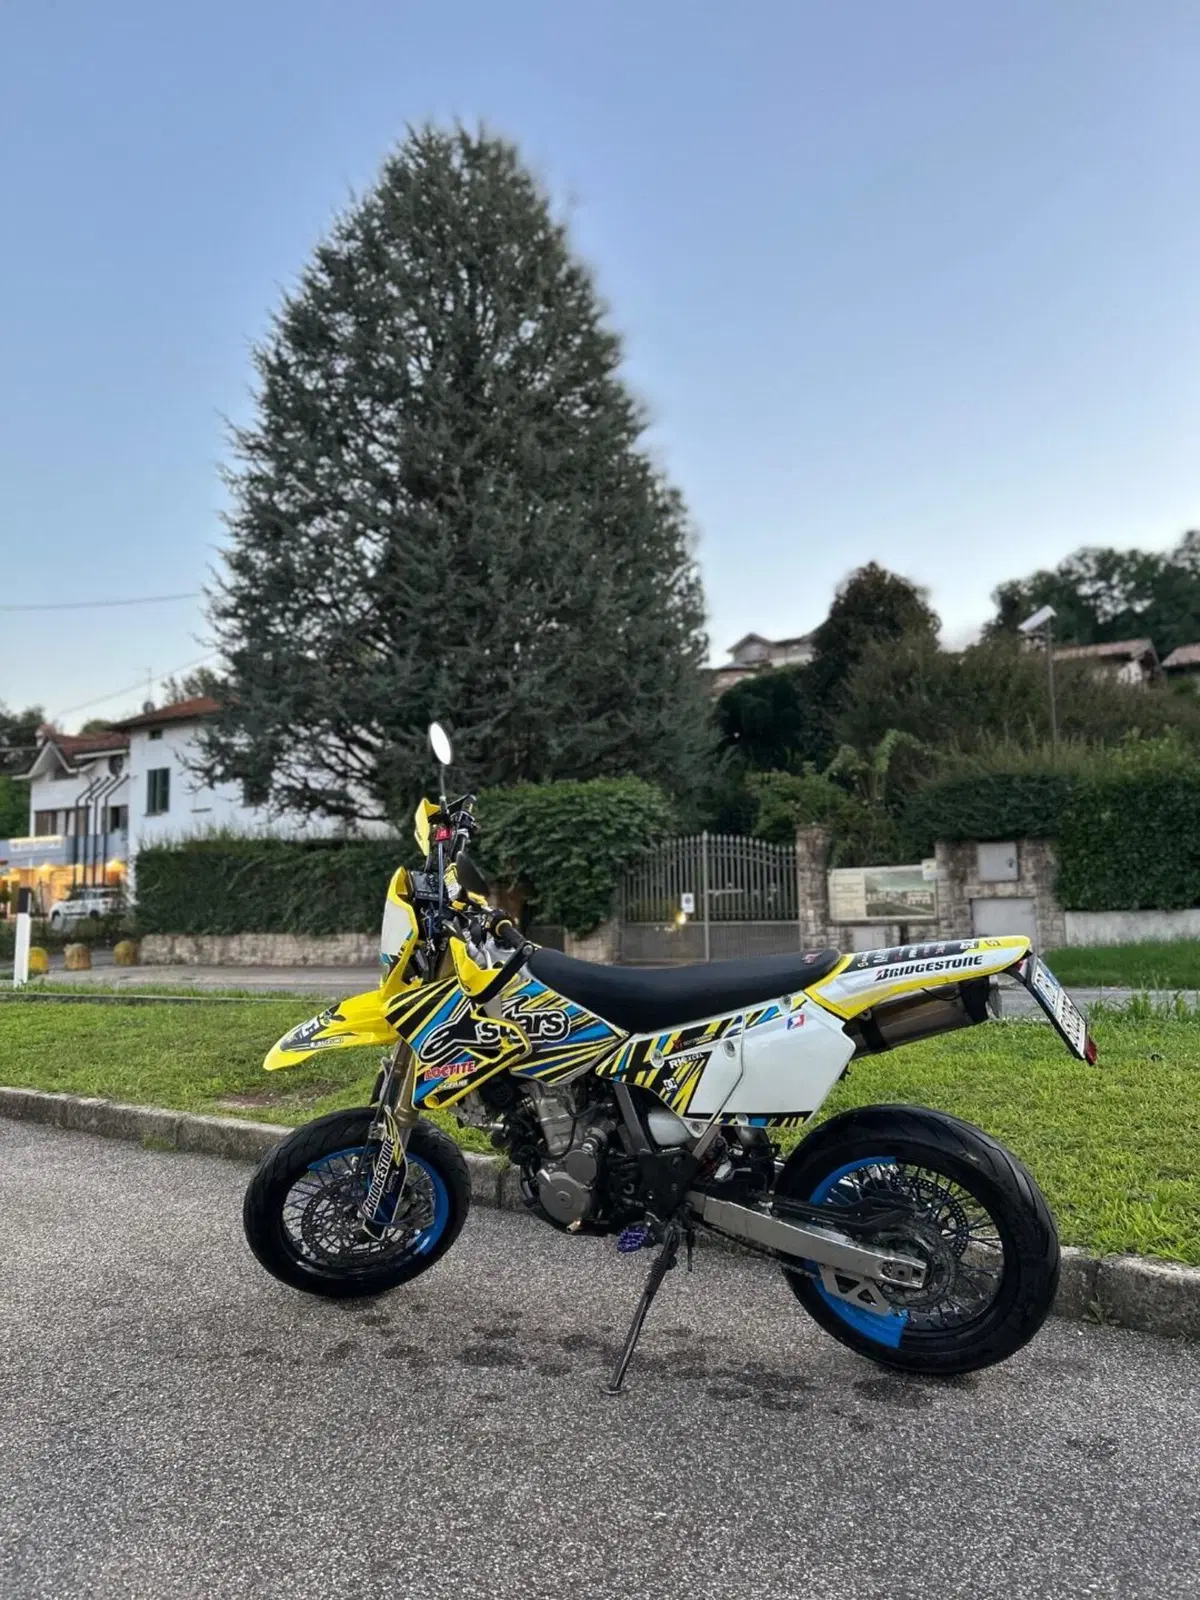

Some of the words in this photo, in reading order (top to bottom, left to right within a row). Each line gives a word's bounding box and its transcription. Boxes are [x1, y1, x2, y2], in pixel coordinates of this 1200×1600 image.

[875, 955, 983, 981] BRIDGESTONE
[424, 1060, 477, 1081] LOCTITE
[669, 1055, 686, 1069] RK
[662, 1077, 678, 1091] DC
[362, 1136, 395, 1220] BRIDGESTONE
